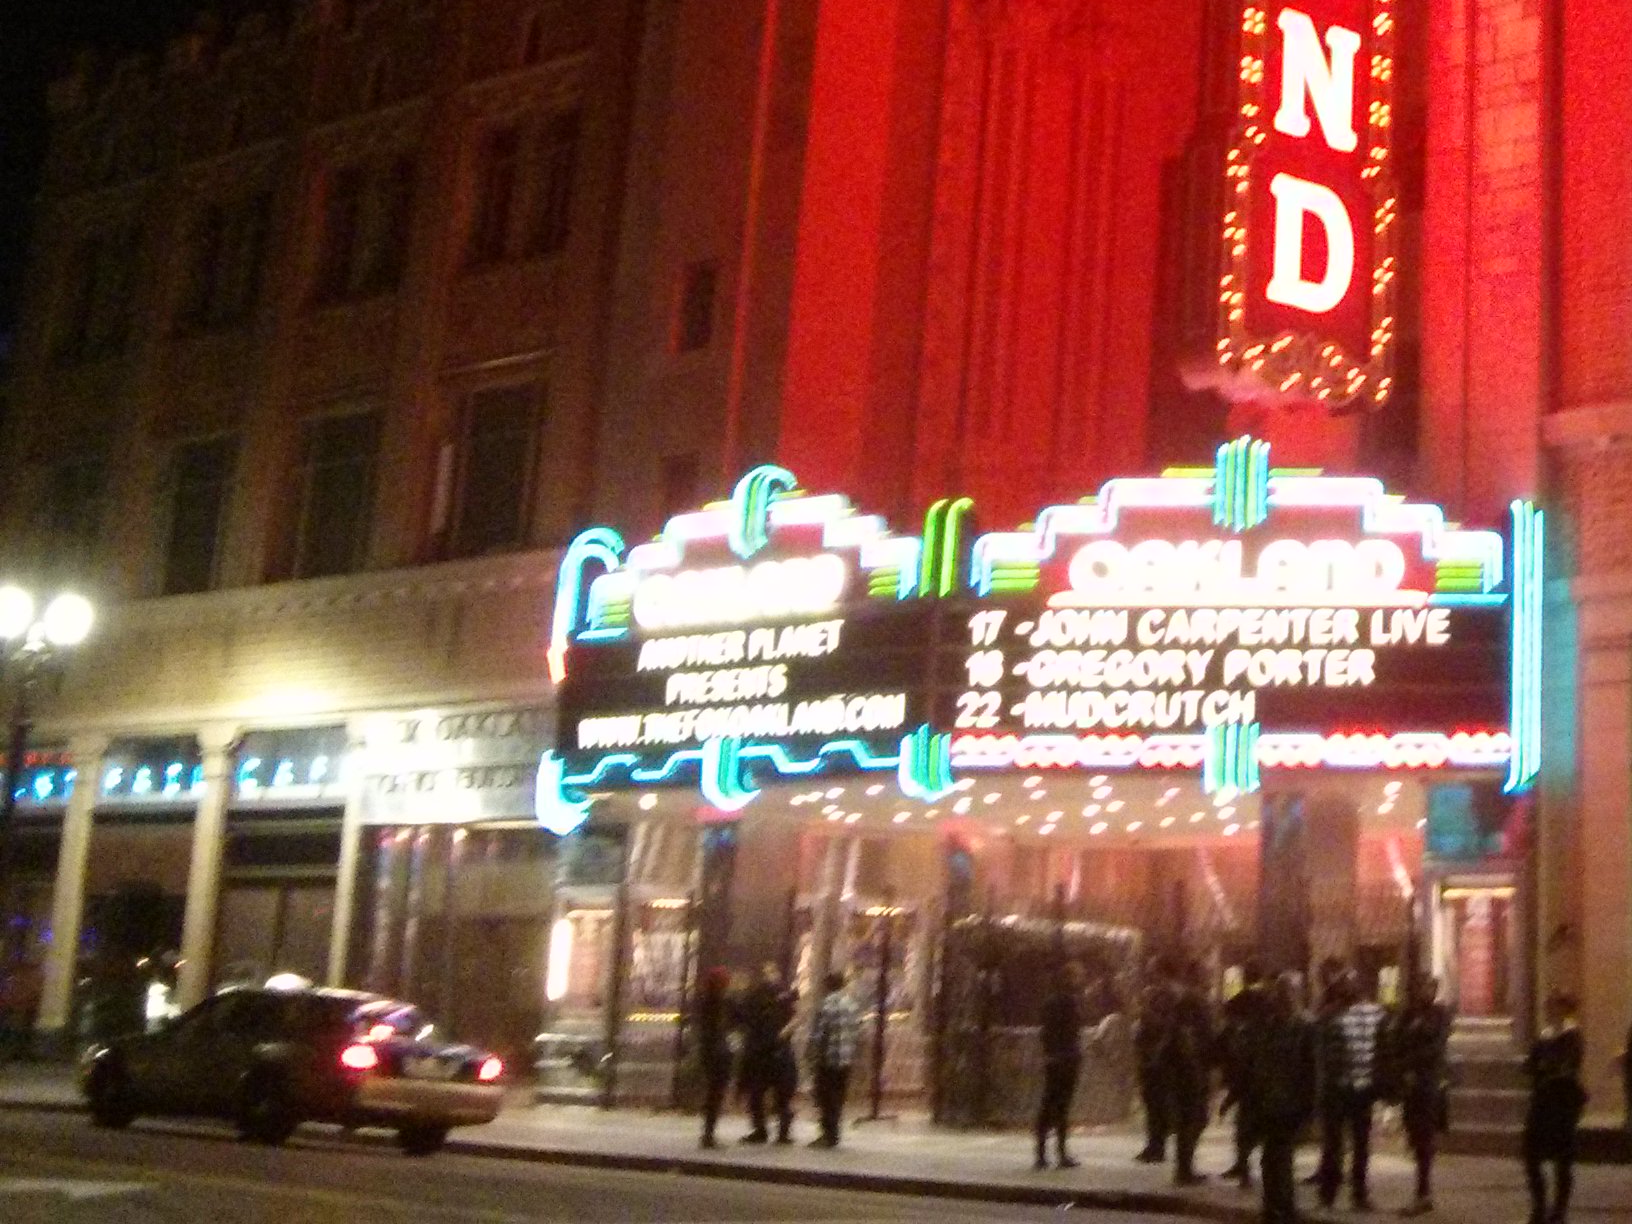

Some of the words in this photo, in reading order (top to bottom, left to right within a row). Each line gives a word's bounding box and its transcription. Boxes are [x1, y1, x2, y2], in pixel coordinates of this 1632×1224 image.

[637, 631, 747, 672] ANOTHER
[748, 619, 844, 660] PLANET
[967, 609, 1007, 646] 17
[1136, 609, 1360, 646] CARPENTER
[1370, 608, 1451, 645] LIVE
[665, 663, 788, 706] PRESENTS
[1223, 648, 1376, 687] PORTER
[955, 690, 1002, 728] 22
